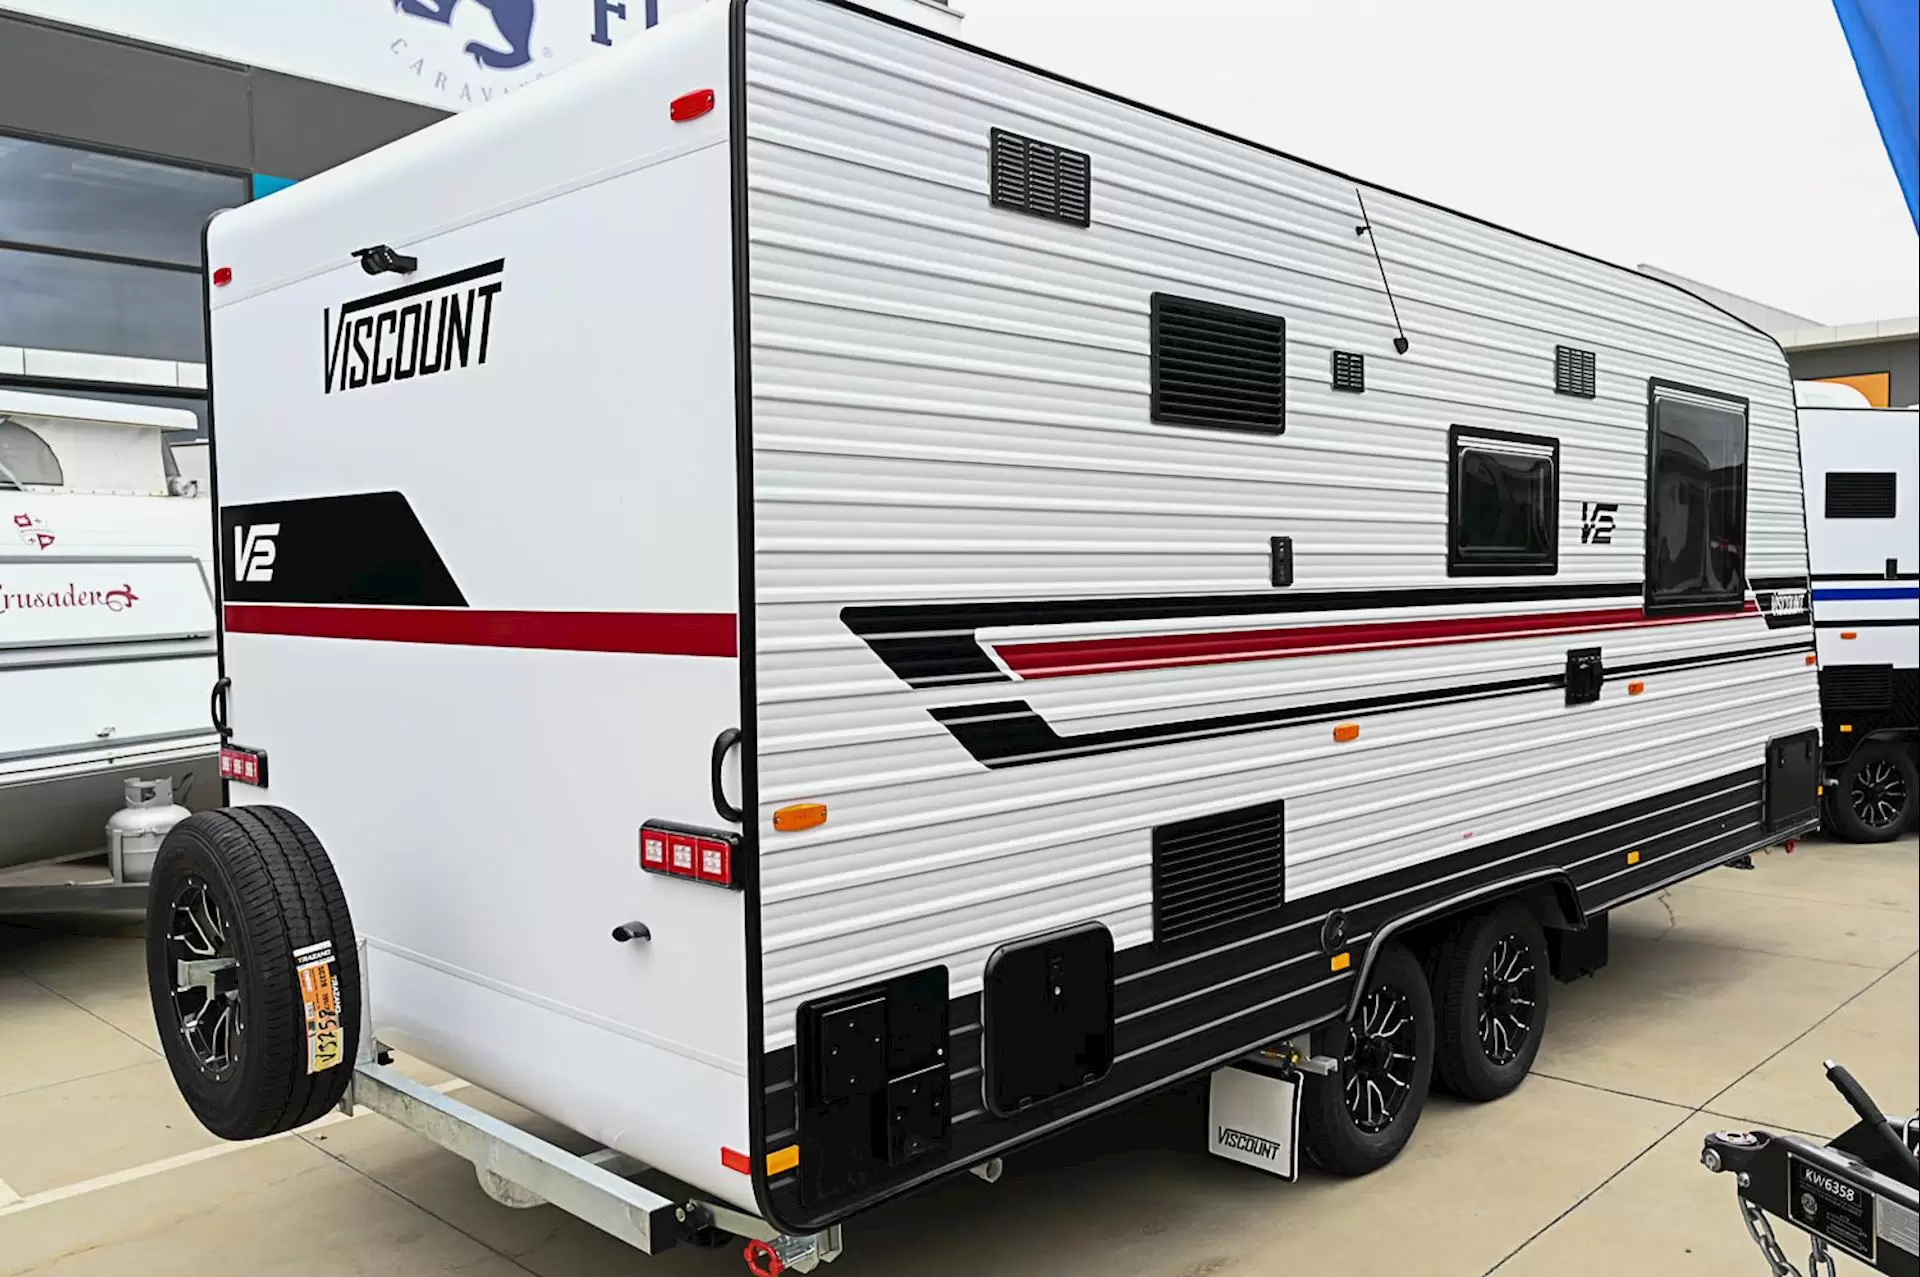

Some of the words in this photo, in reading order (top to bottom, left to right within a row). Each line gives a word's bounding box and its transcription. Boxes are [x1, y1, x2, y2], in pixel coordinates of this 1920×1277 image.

[324, 257, 505, 394] VISCOUNT
[1581, 502, 1619, 544] V2
[234, 523, 280, 582] V2
[1218, 1126, 1281, 1160] VISCOUNT
[1804, 1168, 1856, 1202] KW6358
